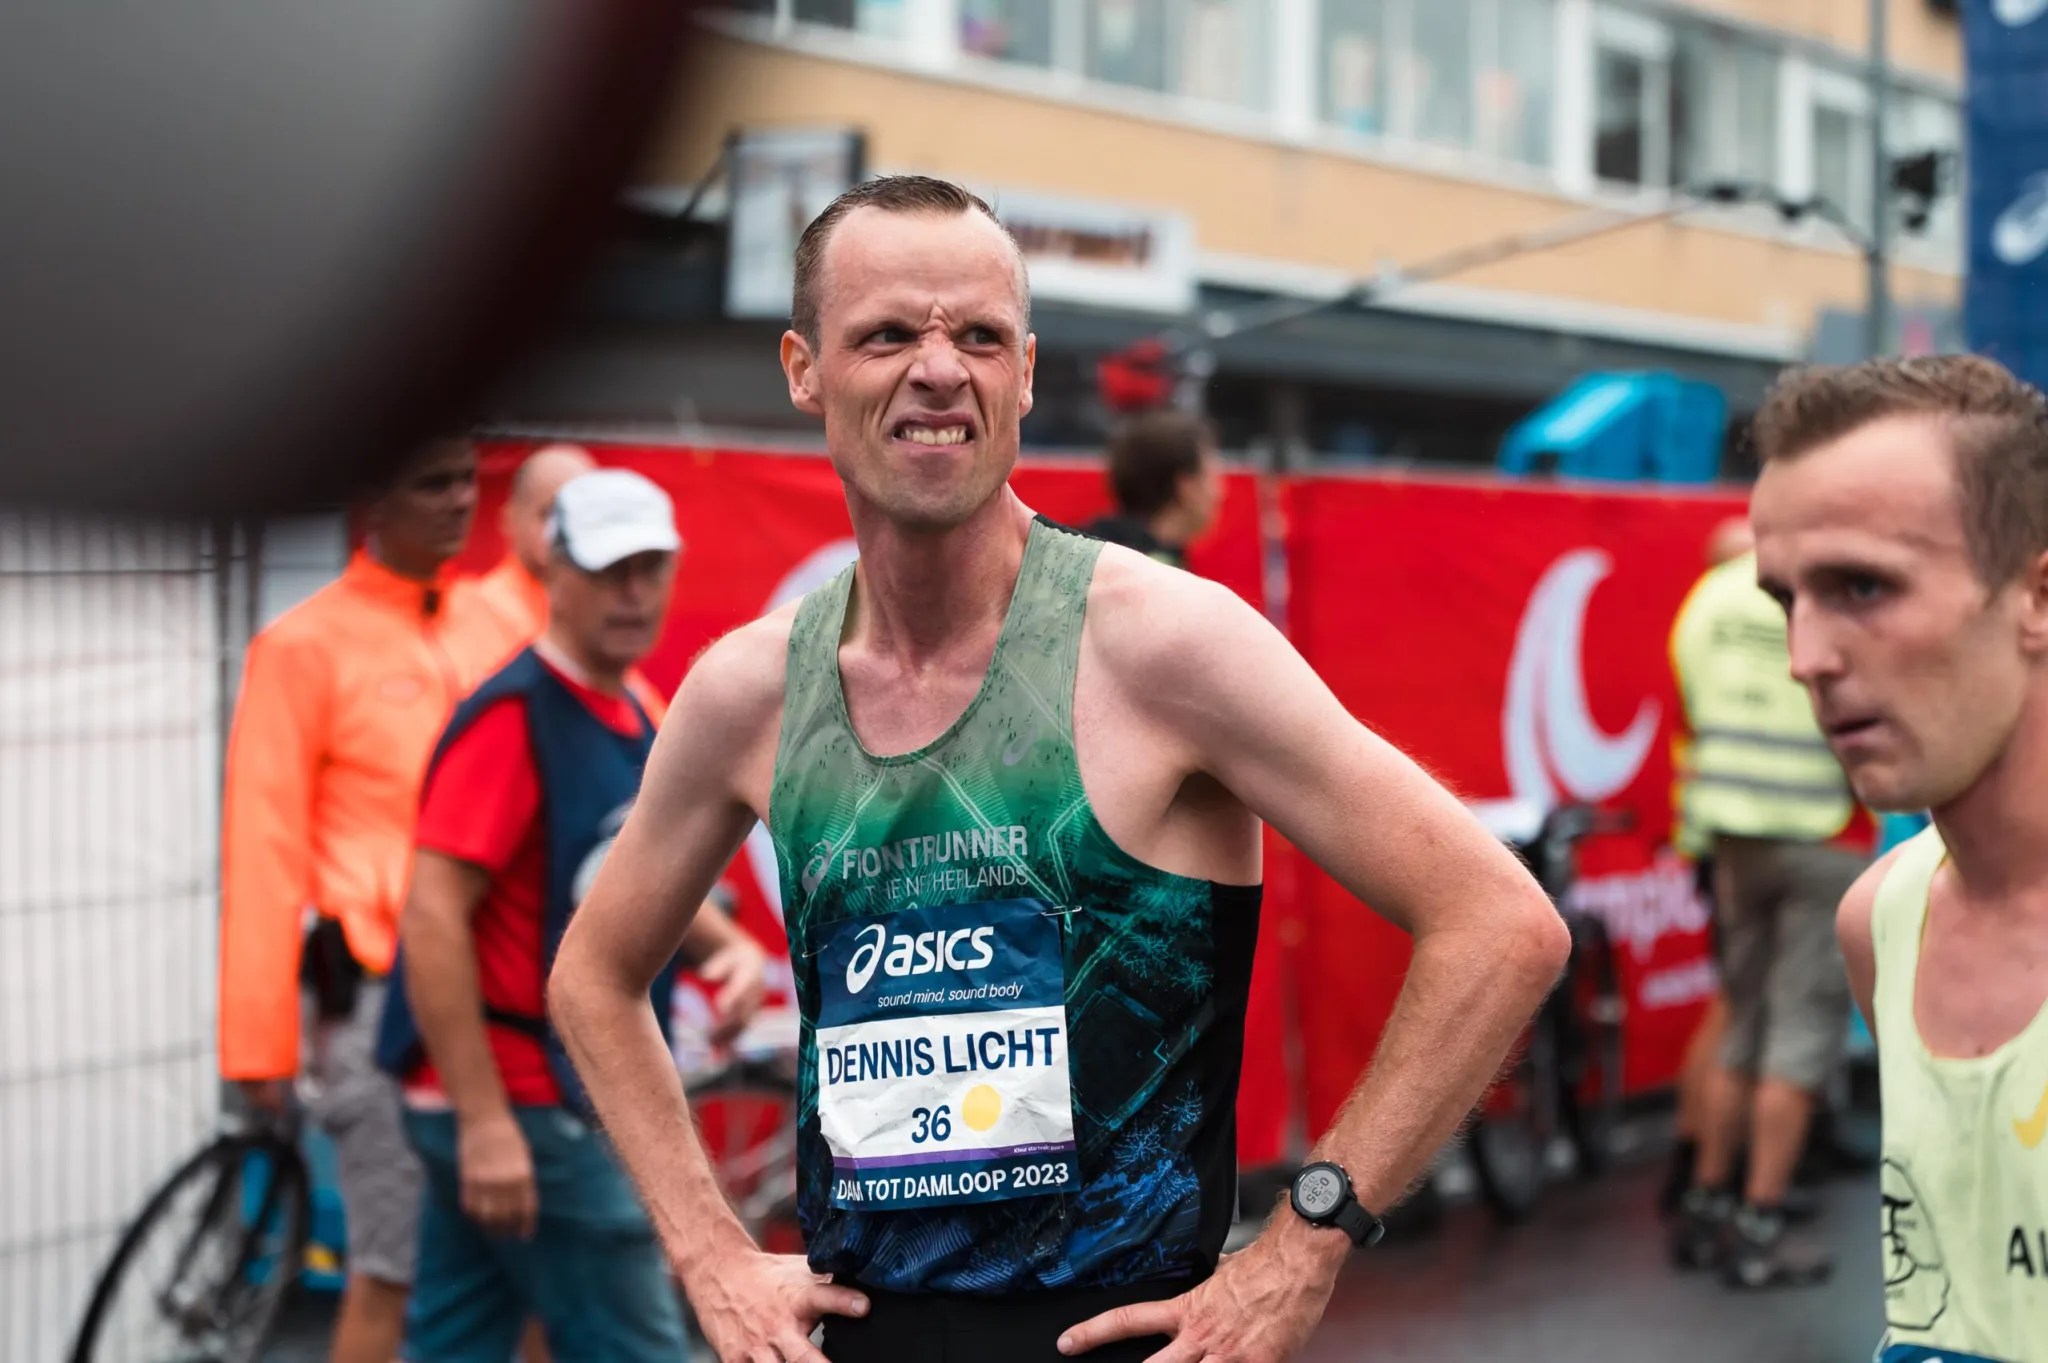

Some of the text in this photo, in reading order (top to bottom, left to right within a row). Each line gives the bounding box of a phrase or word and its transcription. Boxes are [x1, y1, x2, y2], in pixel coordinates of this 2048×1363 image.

[883, 925, 995, 977] asics
[877, 980, 1024, 1008] sound mind, sound body
[826, 1026, 1060, 1086] DENNIS LICHT
[911, 1104, 952, 1144] 36
[836, 1162, 1069, 1202] DAM TOT DAMLOOP 2023
